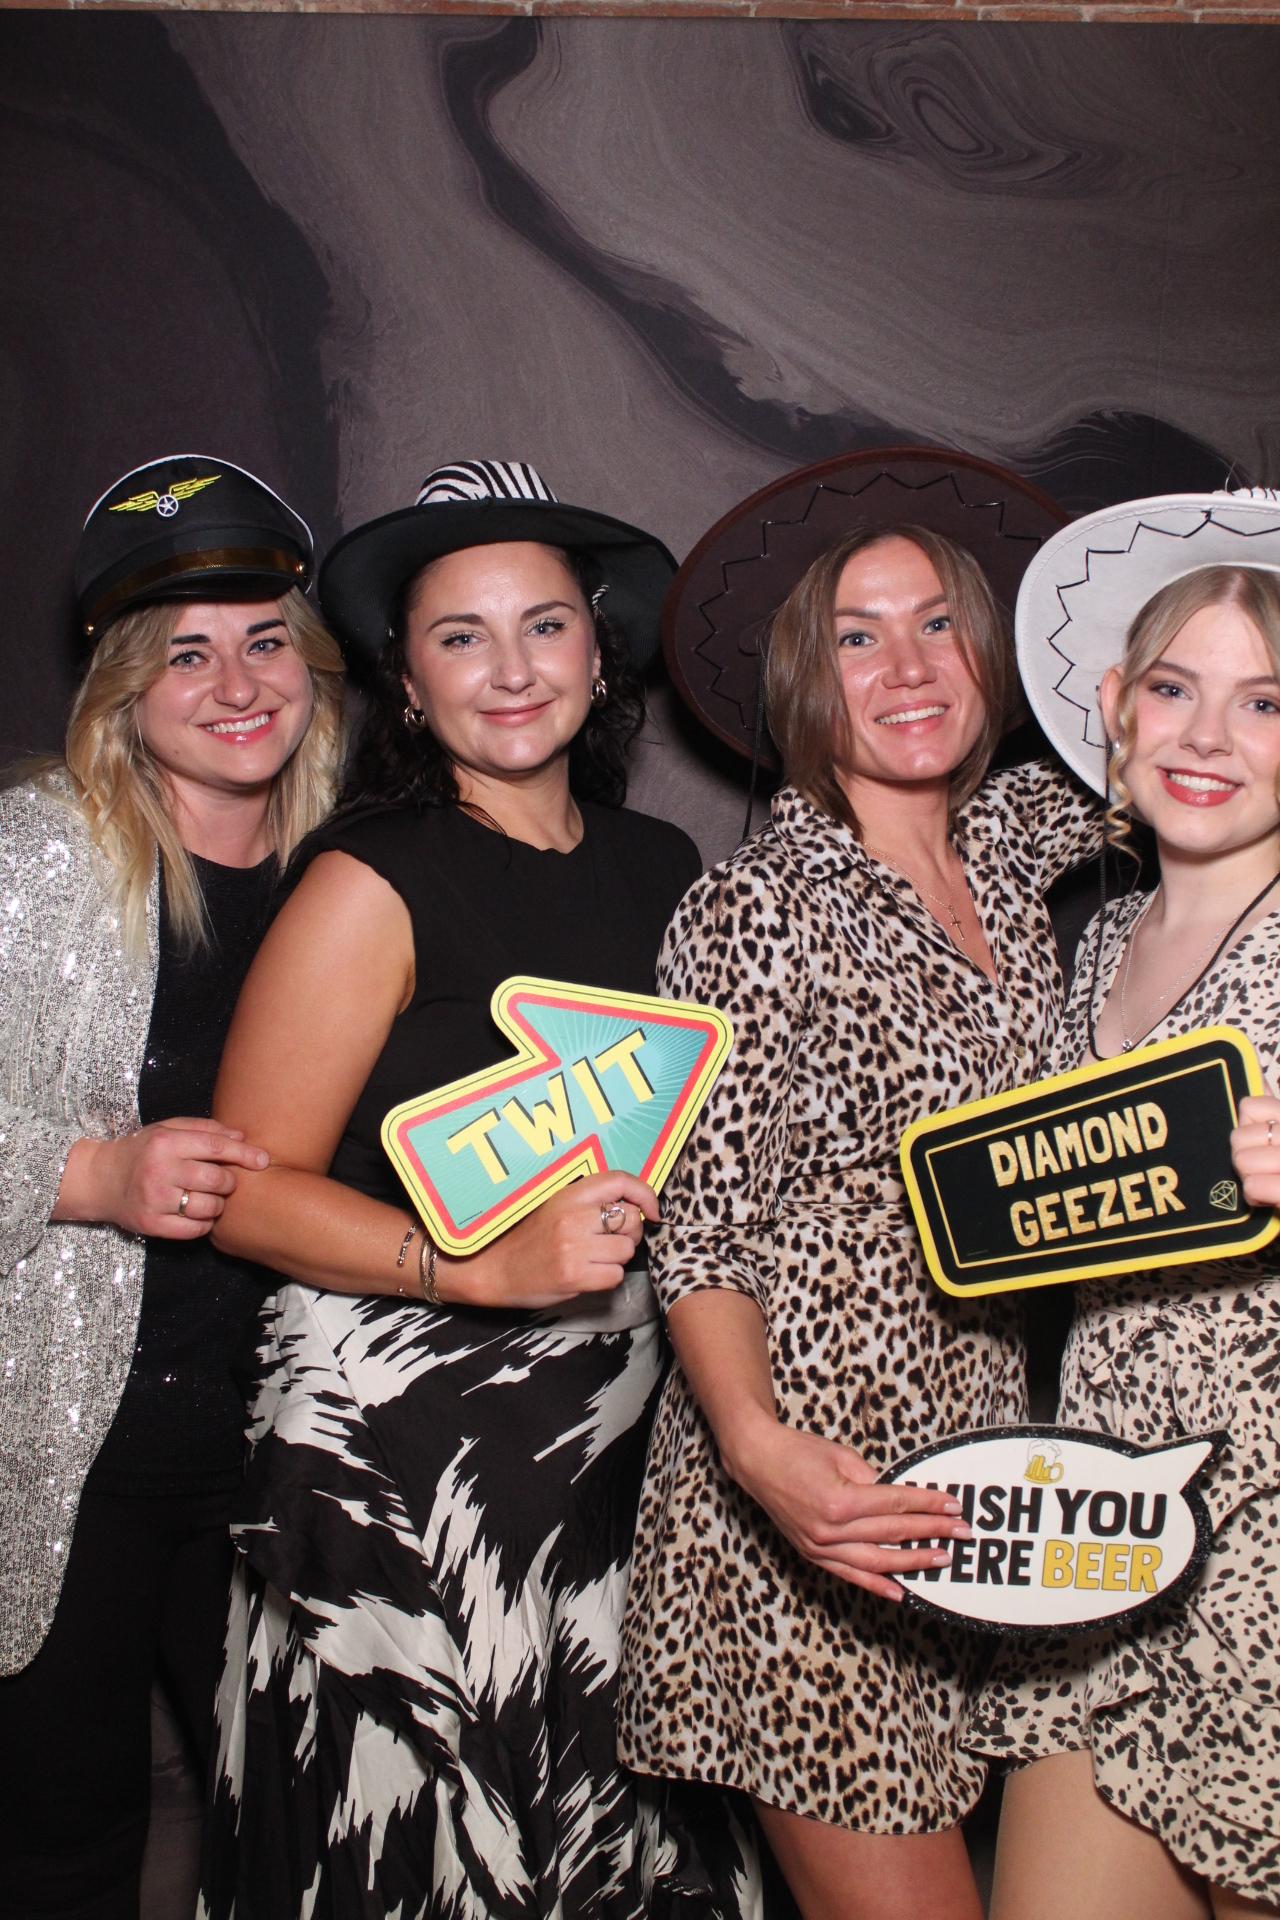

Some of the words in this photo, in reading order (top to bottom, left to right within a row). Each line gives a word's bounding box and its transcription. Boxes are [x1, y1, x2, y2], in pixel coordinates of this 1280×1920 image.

[446, 1028, 655, 1184] TWIT
[988, 1102, 1168, 1187] DIAMOND
[1010, 1165, 1186, 1246] GEEZER
[905, 1481, 1043, 1533] ISH
[1055, 1488, 1167, 1539] YOU
[1041, 1539, 1163, 1593] BEER
